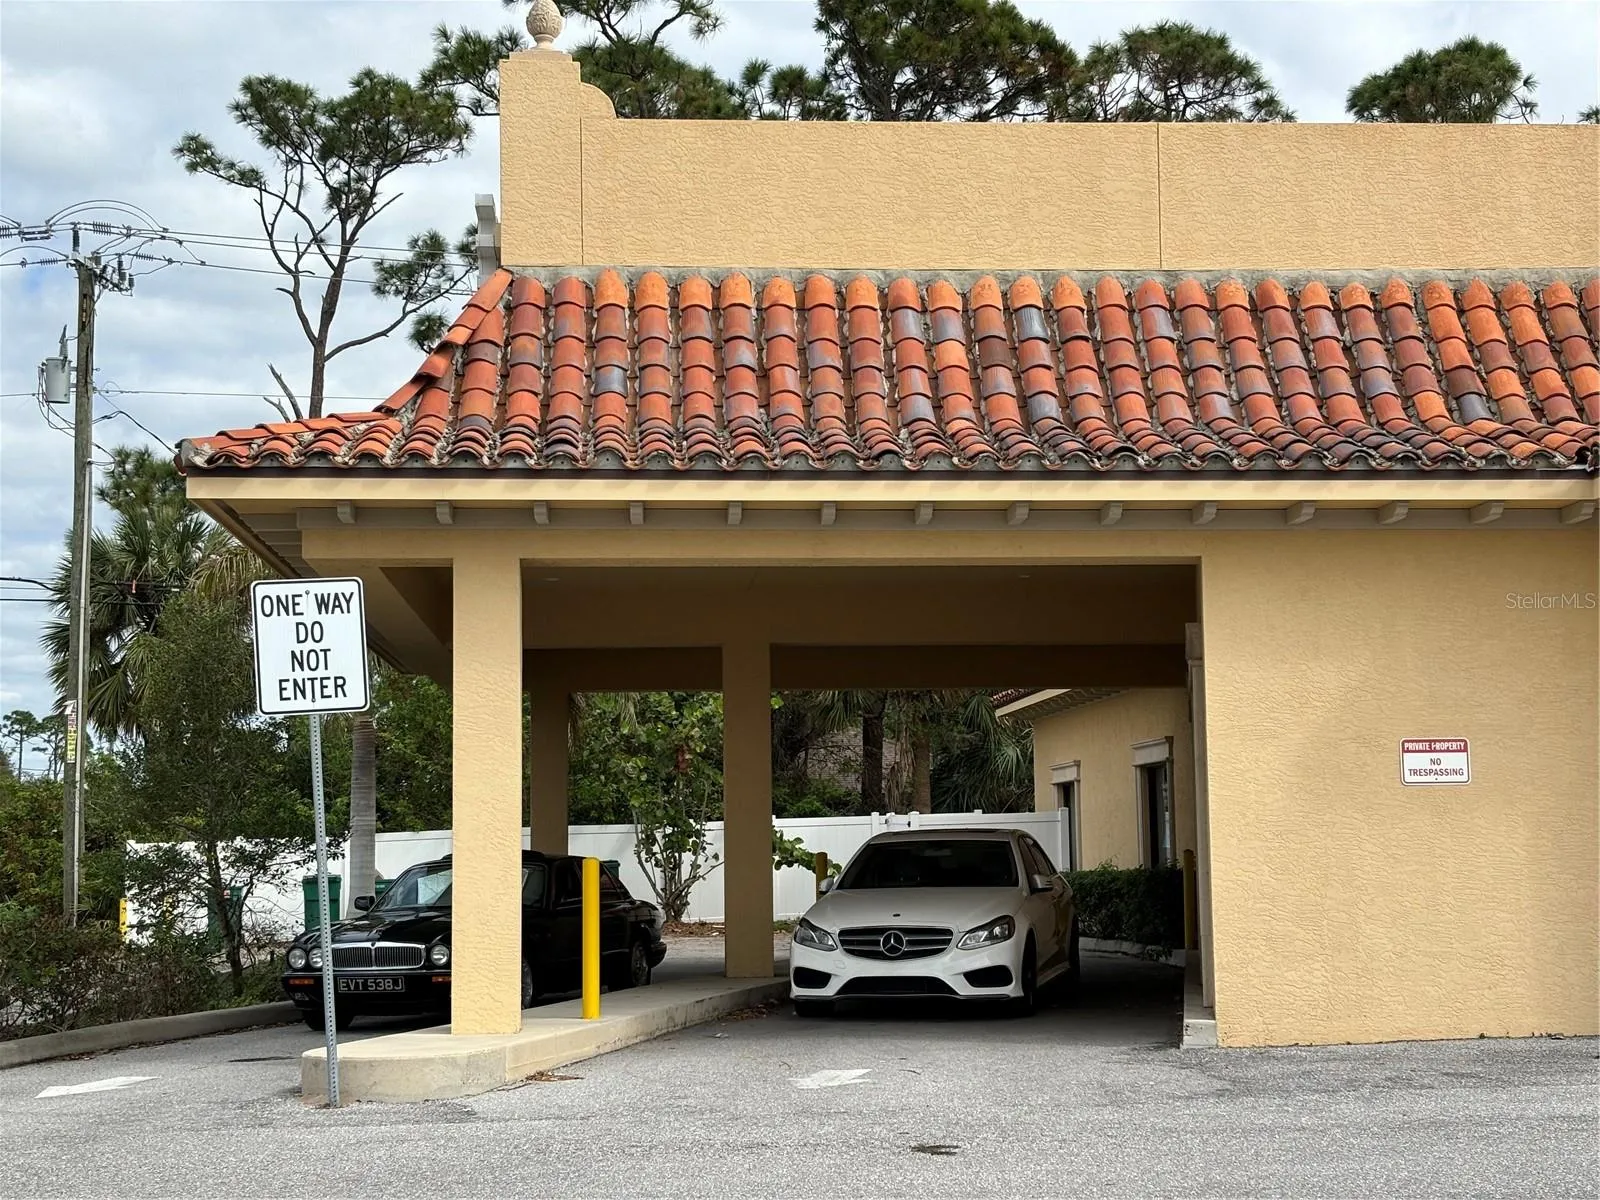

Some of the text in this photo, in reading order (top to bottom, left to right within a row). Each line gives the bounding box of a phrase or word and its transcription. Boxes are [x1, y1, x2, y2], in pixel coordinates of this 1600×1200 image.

[260, 592, 354, 617] ONE WAY
[296, 621, 324, 644] DO
[290, 648, 331, 672] NOT
[278, 676, 347, 701] ENTER
[1404, 742, 1465, 751] PRIVATE PROPERTY
[1430, 757, 1441, 766] NO
[1408, 768, 1464, 776] TRESPASSING
[340, 979, 402, 990] EVT 538J
